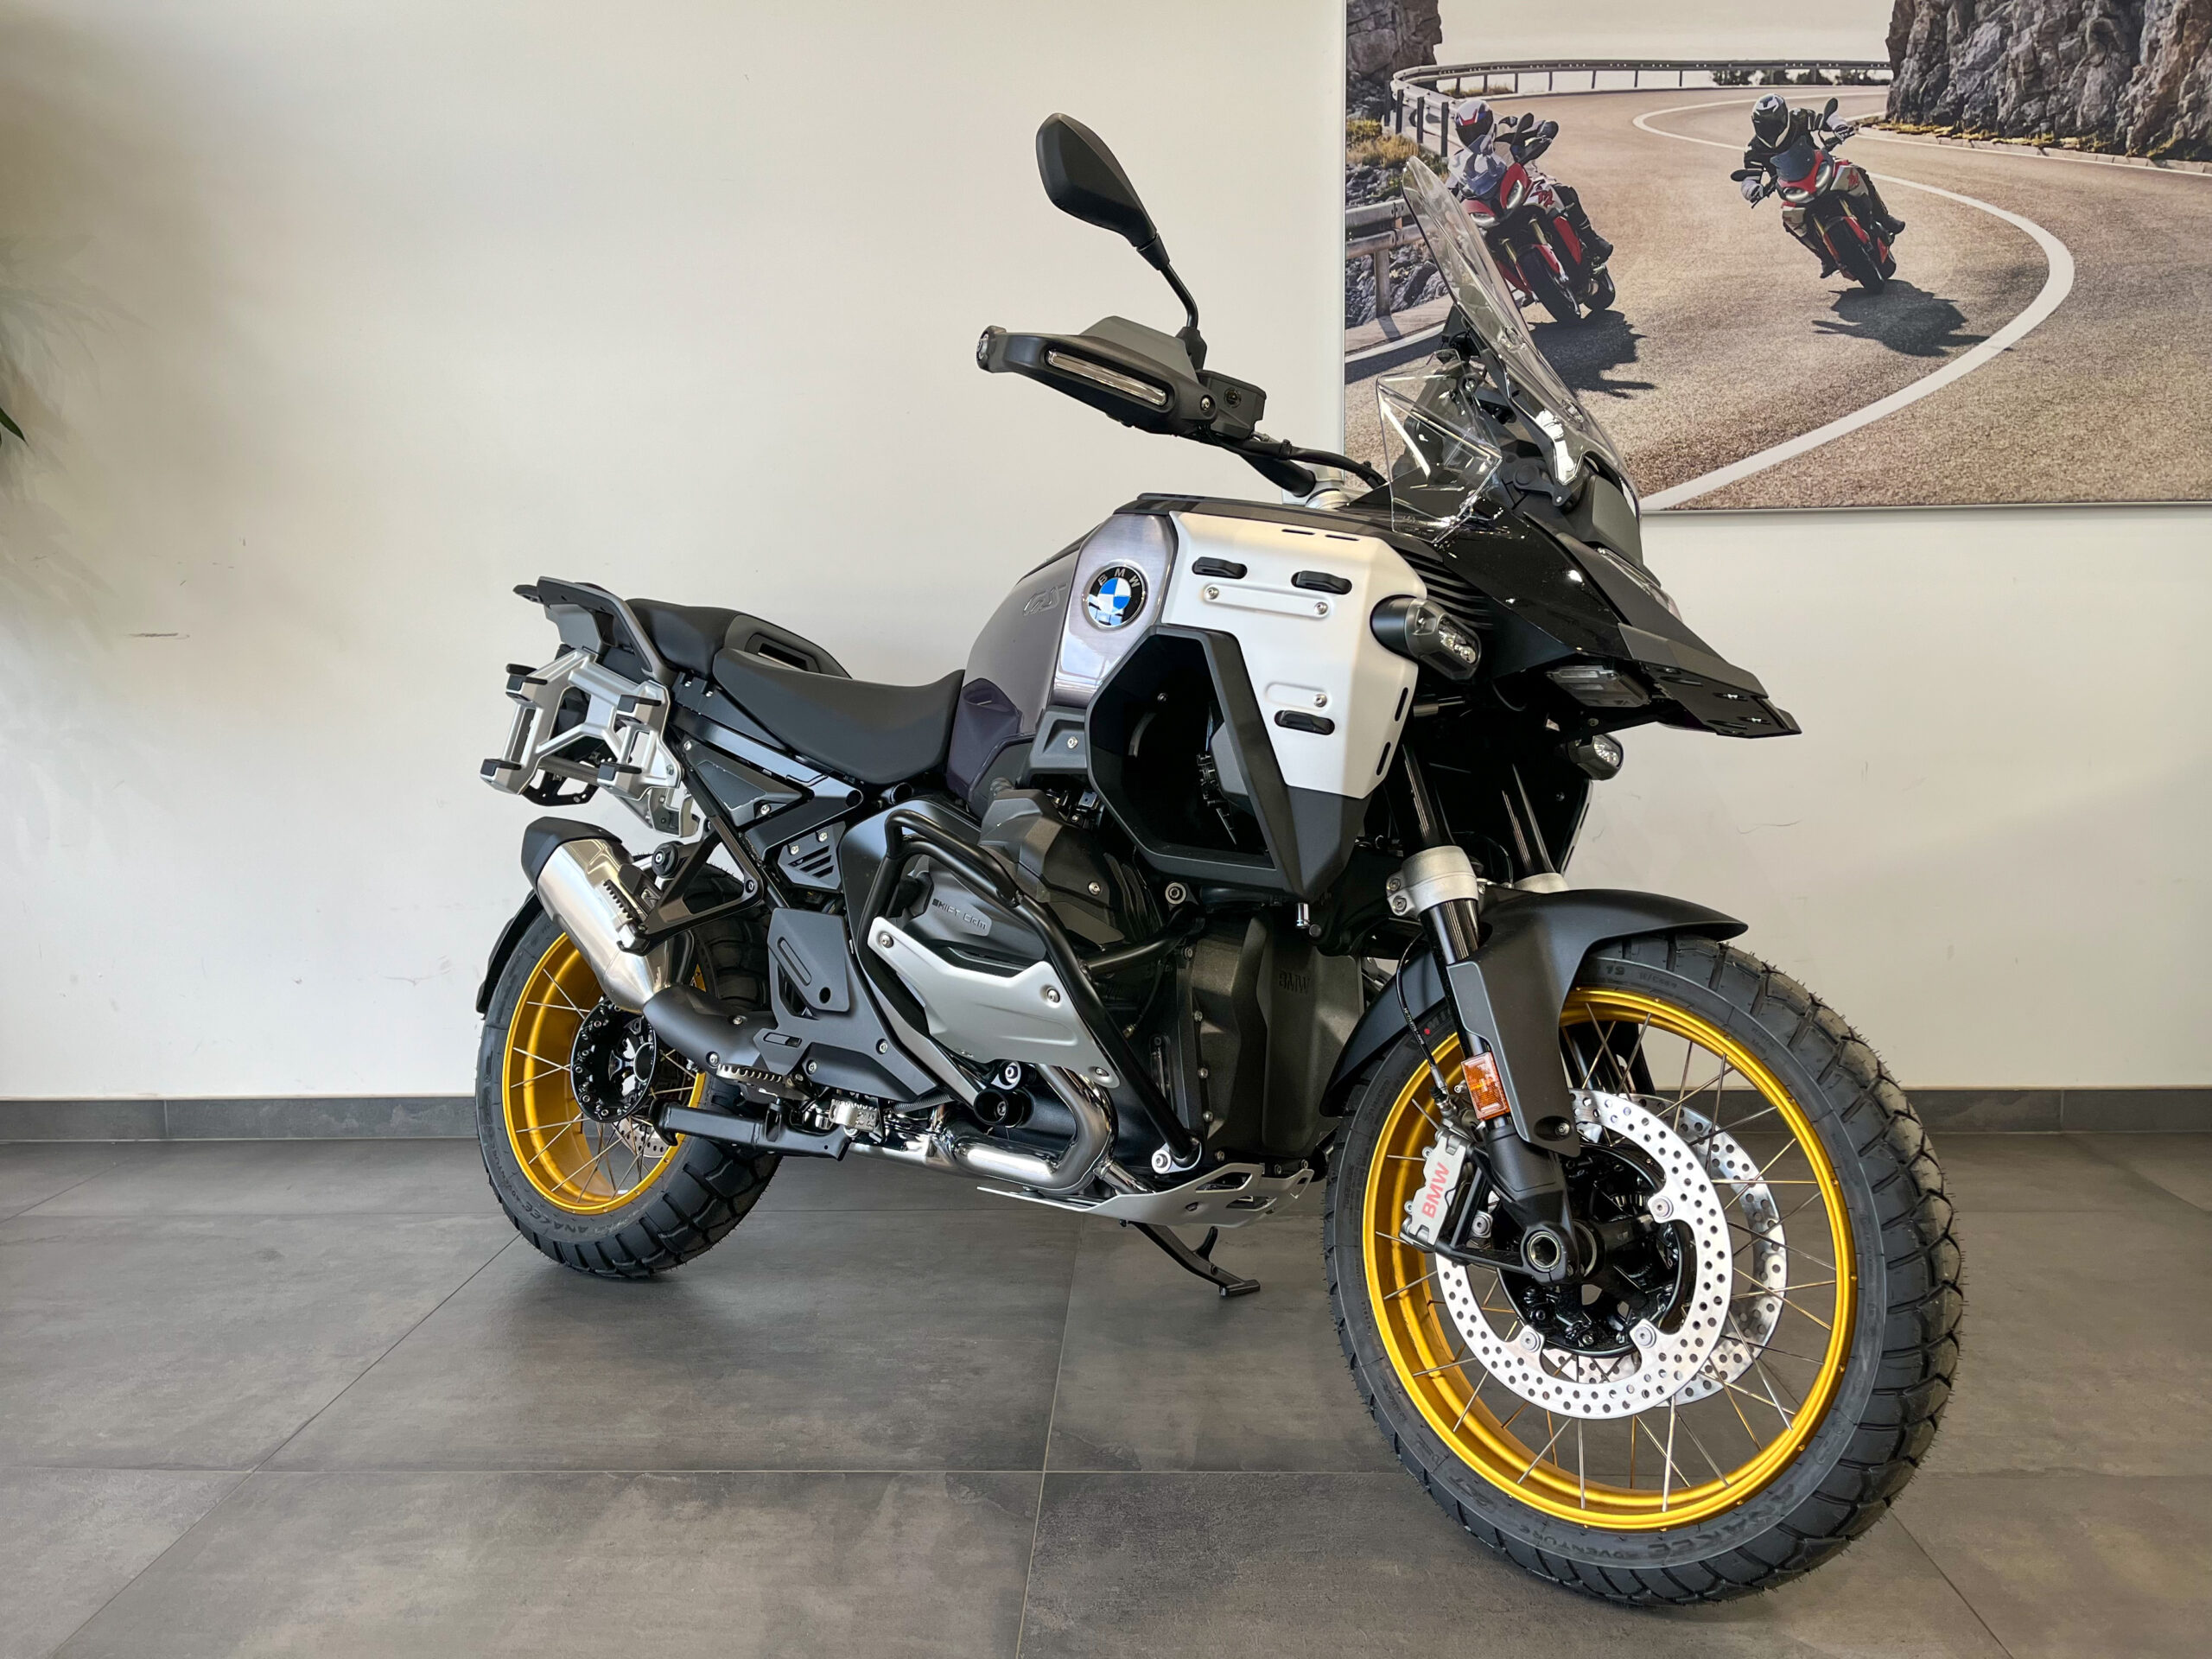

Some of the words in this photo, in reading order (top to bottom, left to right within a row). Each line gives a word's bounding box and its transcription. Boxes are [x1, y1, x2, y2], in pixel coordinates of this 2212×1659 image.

[1097, 567, 1141, 588] BMW
[931, 898, 961, 917] SHIFT
[1278, 969, 1312, 995] BMW
[1421, 1161, 1450, 1219] BMW
[521, 1201, 589, 1234] ANAKEE
[1647, 1483, 1796, 1560] ANAKEE
